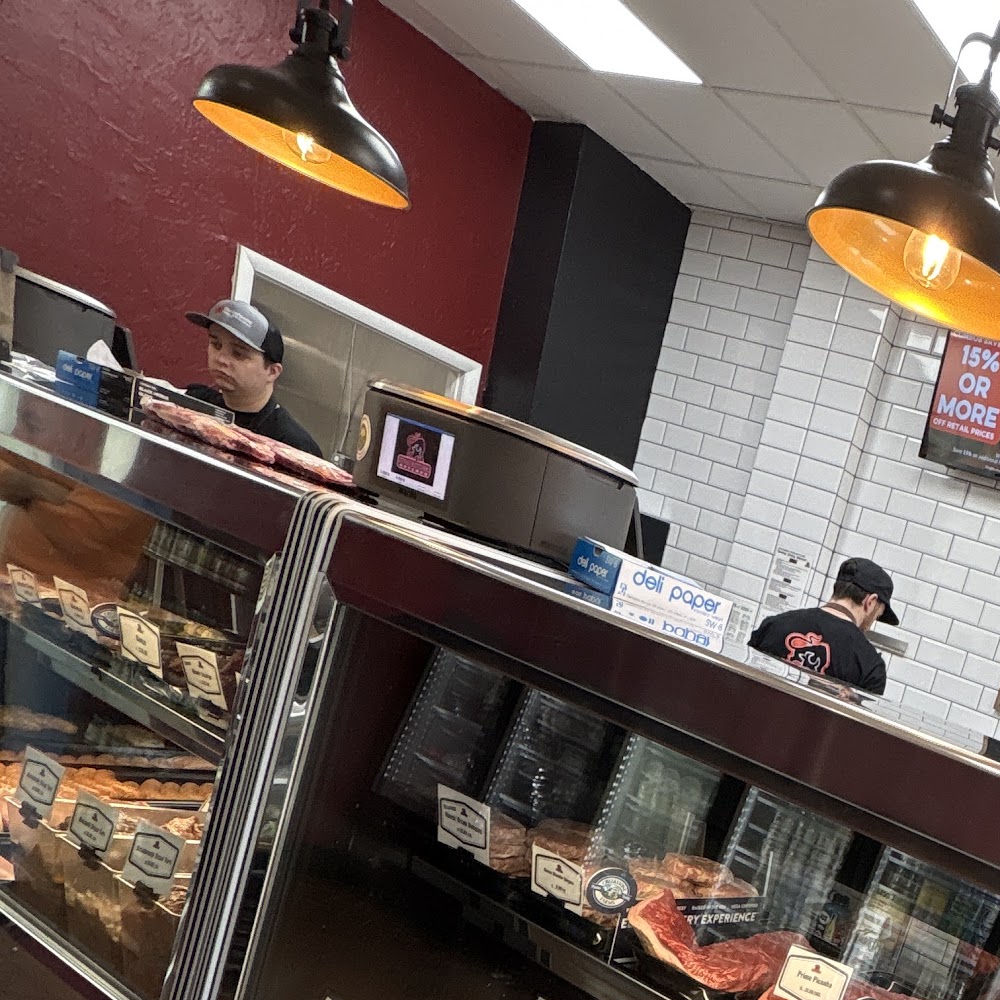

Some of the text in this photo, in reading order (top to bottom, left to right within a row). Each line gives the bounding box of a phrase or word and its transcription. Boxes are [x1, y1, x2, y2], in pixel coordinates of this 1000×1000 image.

[962, 345, 1000, 373] 15%
[959, 372, 991, 399] OR
[937, 394, 1000, 428] MORE
[933, 418, 995, 440] OFF RETAIL PRICES
[577, 555, 609, 578] deli paper
[632, 569, 721, 614] deli paper
[701, 911, 757, 925] EXPERIENCE
[796, 970, 833, 989] Prime Picanha
